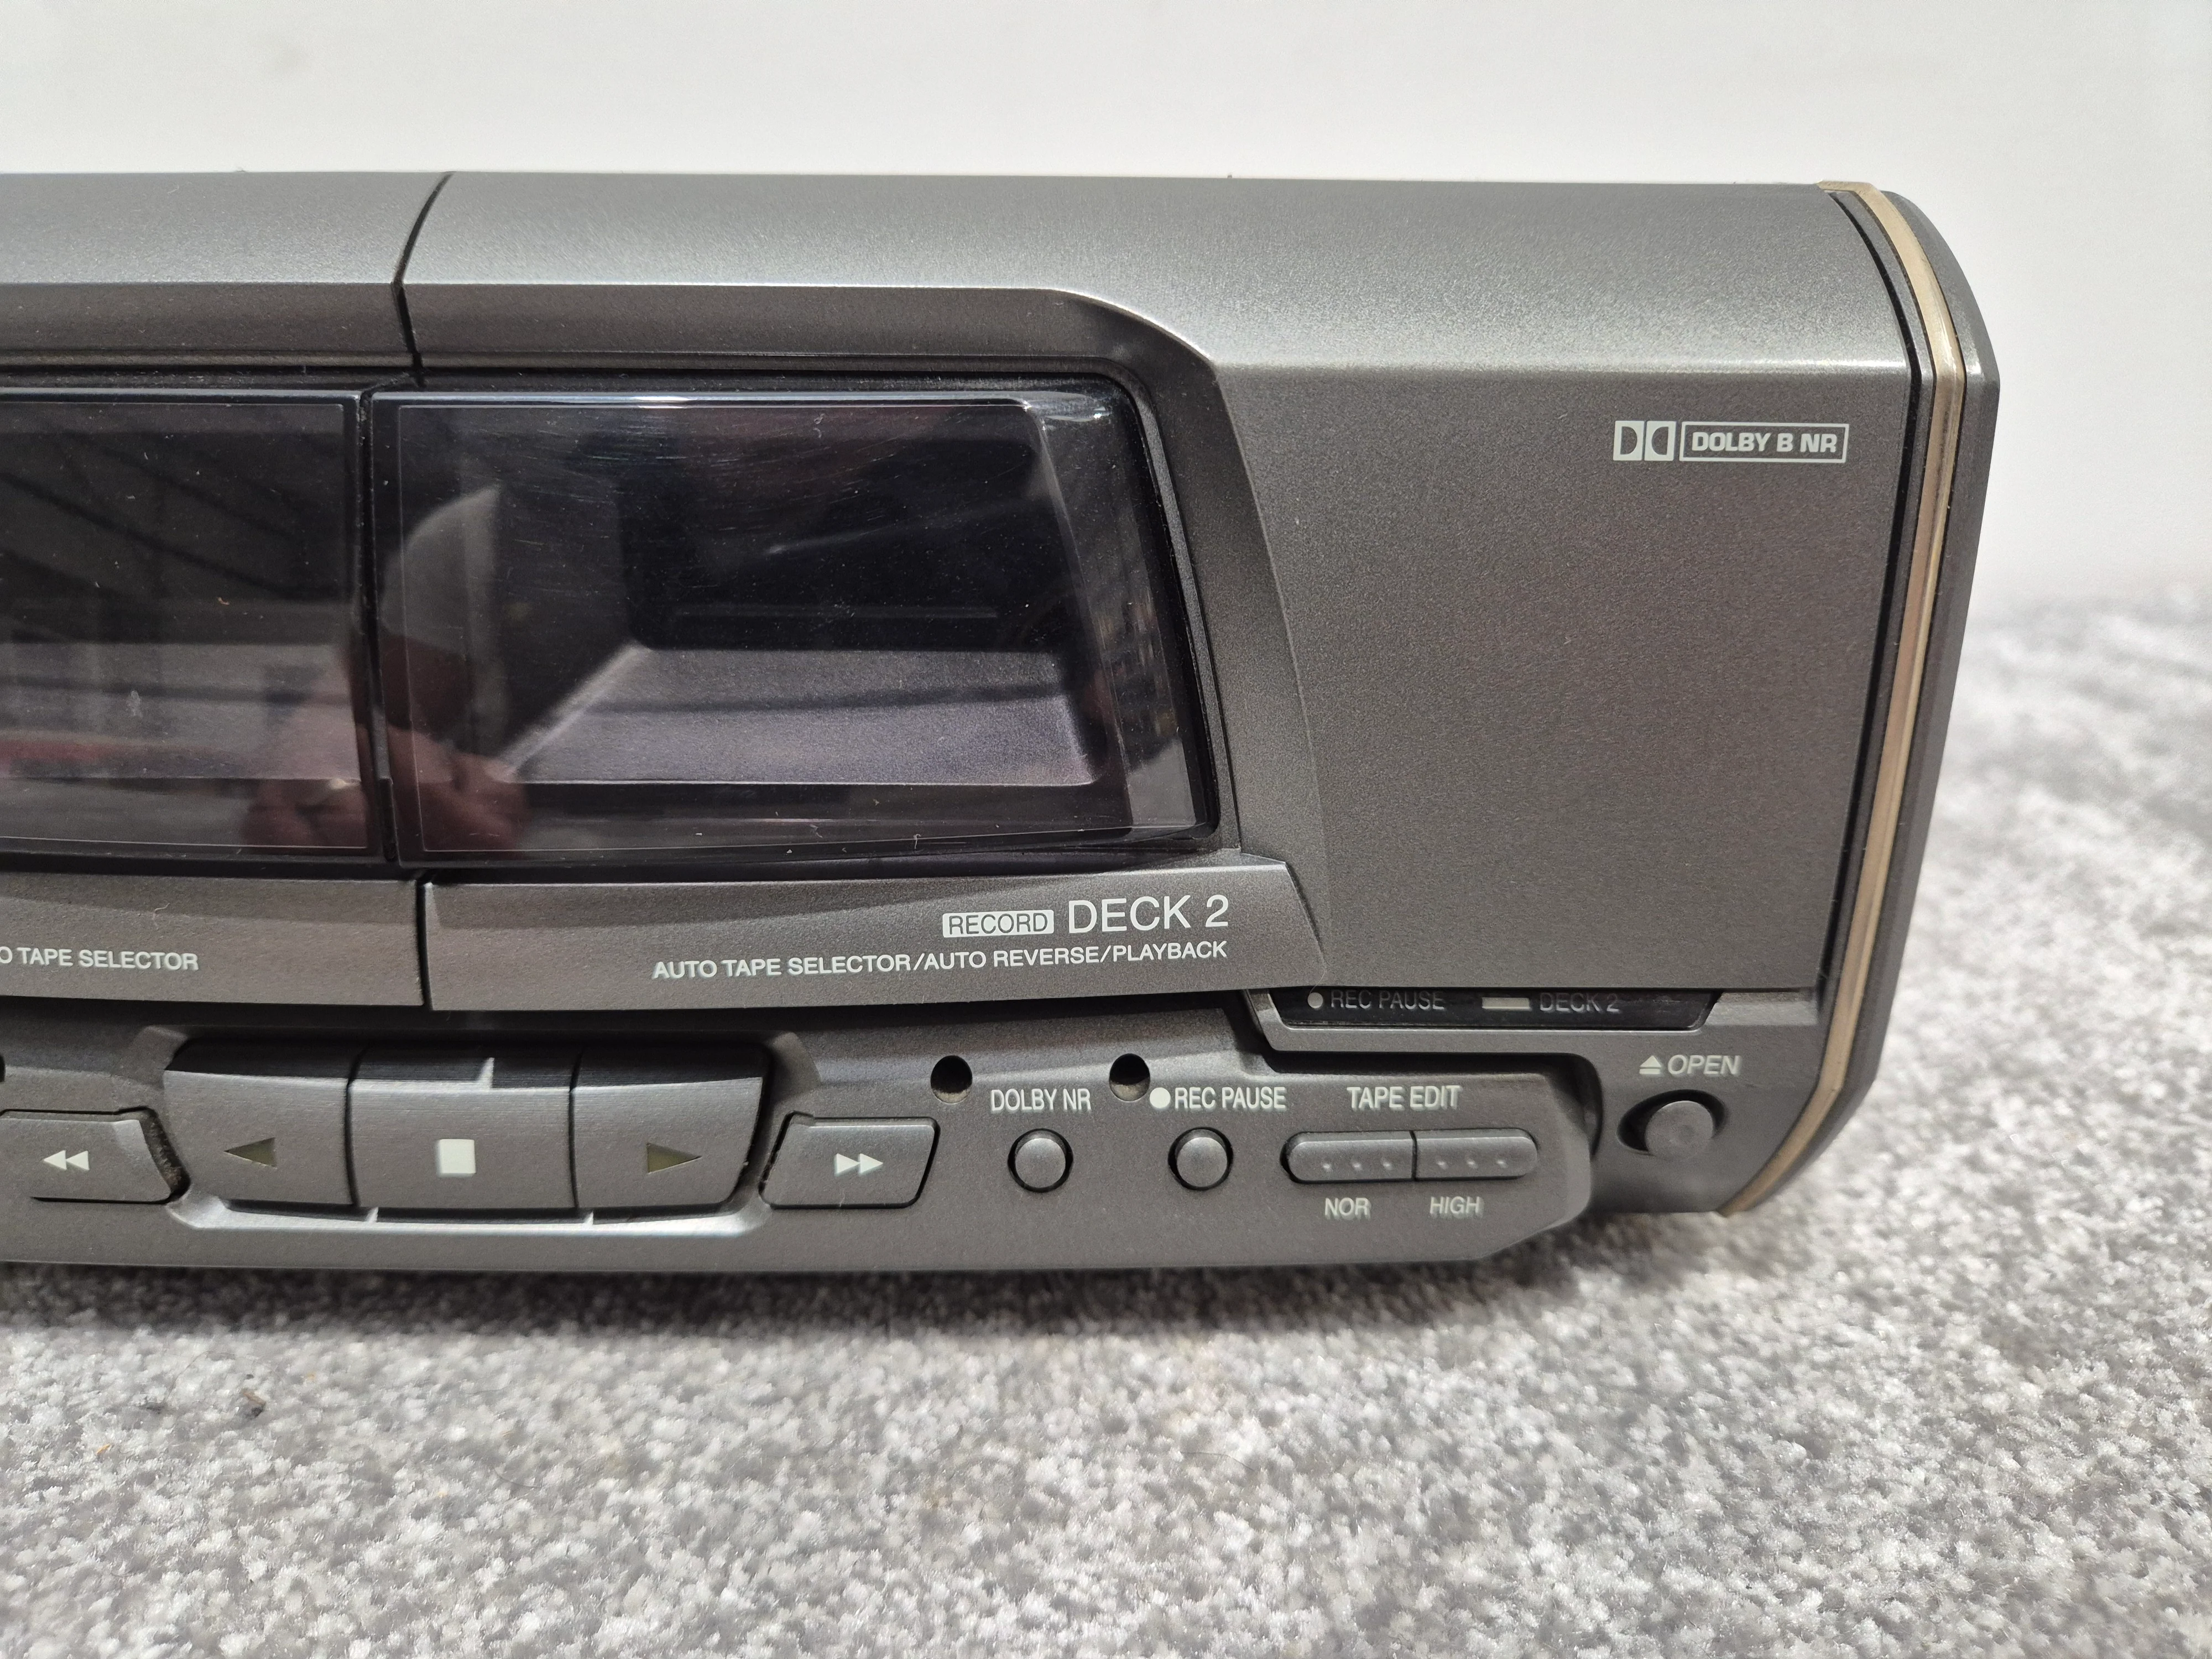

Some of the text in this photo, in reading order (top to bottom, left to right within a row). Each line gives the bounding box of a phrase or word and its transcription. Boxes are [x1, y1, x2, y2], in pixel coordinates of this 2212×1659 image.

[1692, 431, 1838, 453] DOLBY B NR
[948, 894, 1230, 935] RECORD DECK 2
[17, 947, 74, 966] TAPE
[78, 949, 199, 970] SELECTOR
[652, 959, 718, 980] AUTO
[721, 957, 782, 977] TAPE
[1329, 990, 1446, 1011] REC PAUSE
[1539, 993, 1620, 1013] DECK 2
[1667, 1054, 1741, 1075] OPEN
[990, 1088, 1092, 1113] DOLBY NR
[1174, 1086, 1287, 1110] REC PAUSE
[1346, 1084, 1462, 1110] TAPE EDIT
[1324, 1197, 1371, 1217] NOR
[1429, 1196, 1484, 1217] HIGH
